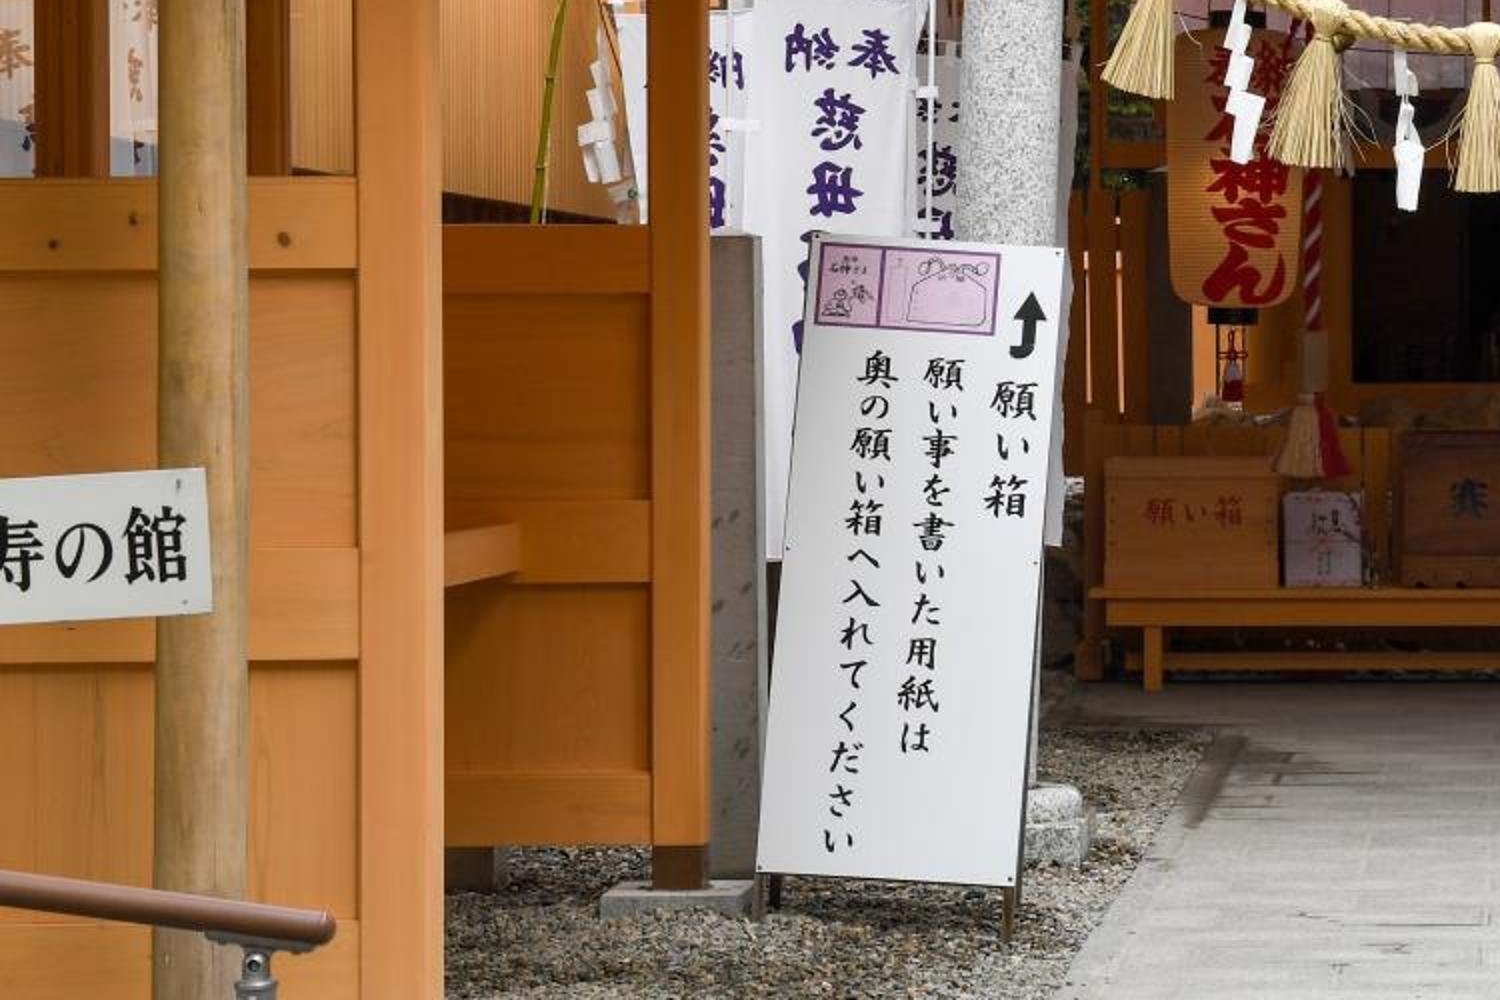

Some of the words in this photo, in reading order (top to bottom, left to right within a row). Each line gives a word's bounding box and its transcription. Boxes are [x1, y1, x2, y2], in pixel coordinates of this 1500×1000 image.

[0, 505, 187, 592] 寿の館
[897, 356, 966, 756] 願い事を書いた用紙は
[984, 379, 1039, 520] 願い箱
[824, 348, 900, 854] 奥の願い箱へ入れてください
